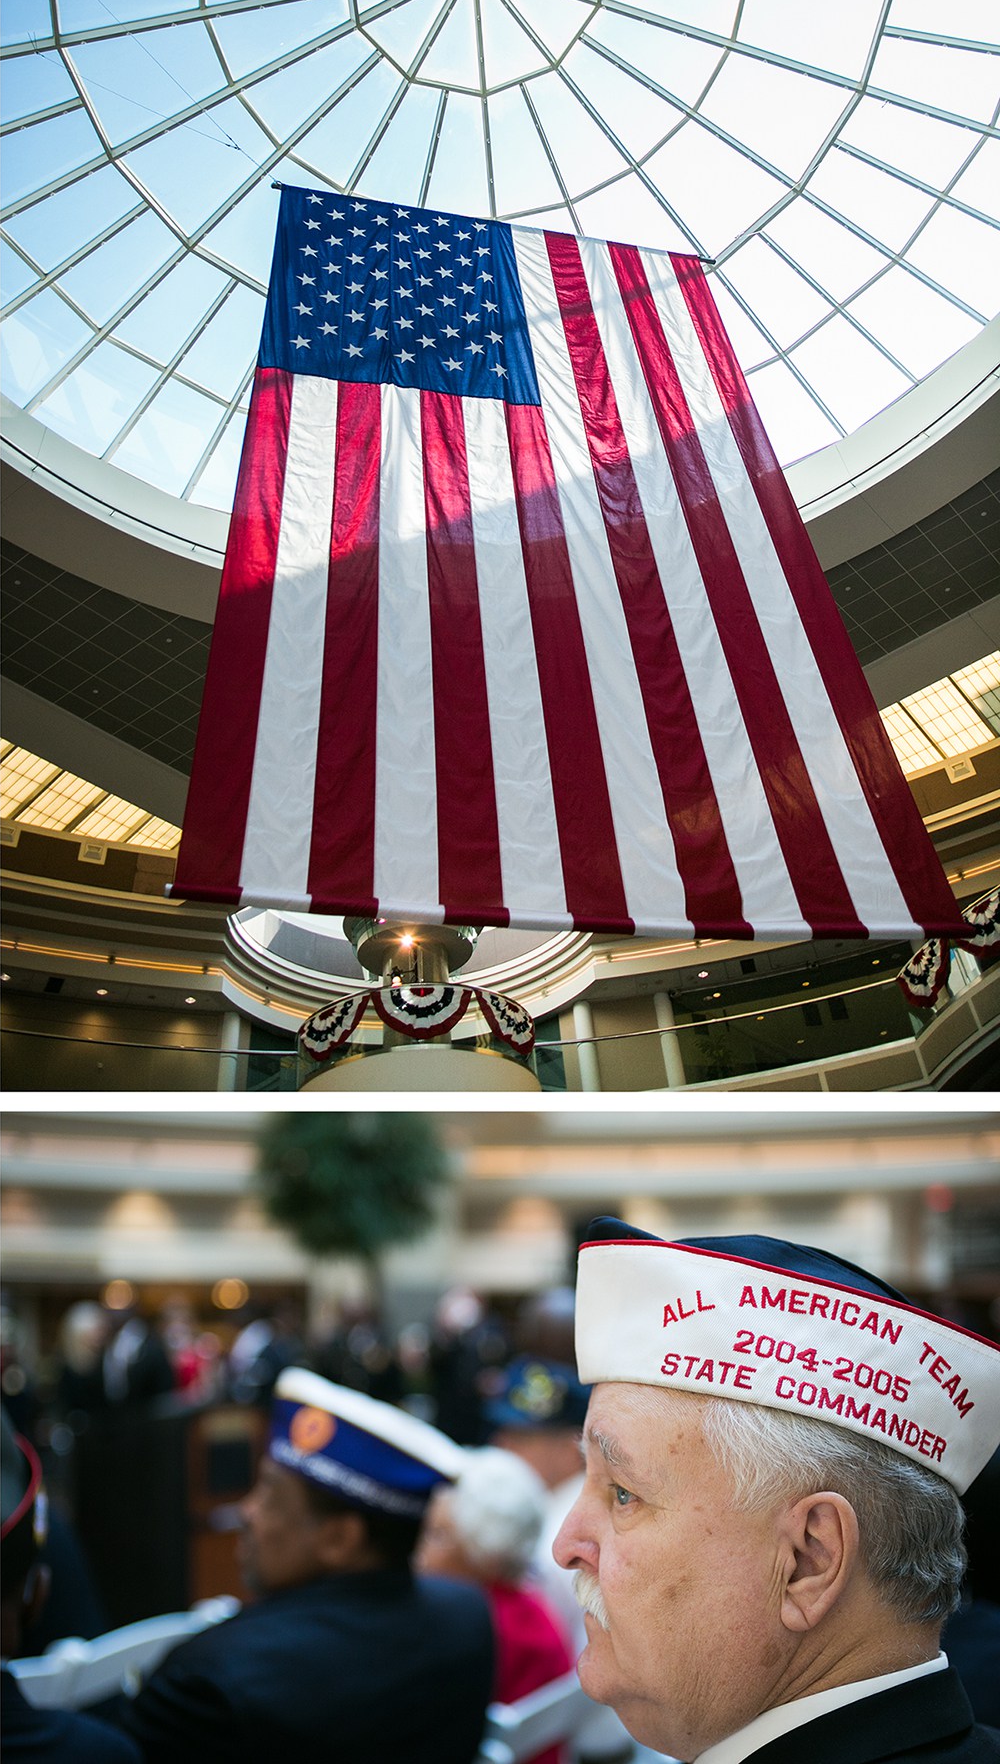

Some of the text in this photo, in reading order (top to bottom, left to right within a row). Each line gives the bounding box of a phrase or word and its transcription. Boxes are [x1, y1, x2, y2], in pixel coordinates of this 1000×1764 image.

[659, 1351, 948, 1464] STATE COMMANDER
[661, 1284, 976, 1420] ALL AMERICAN TEAM
[732, 1328, 912, 1404] 2004-2005
